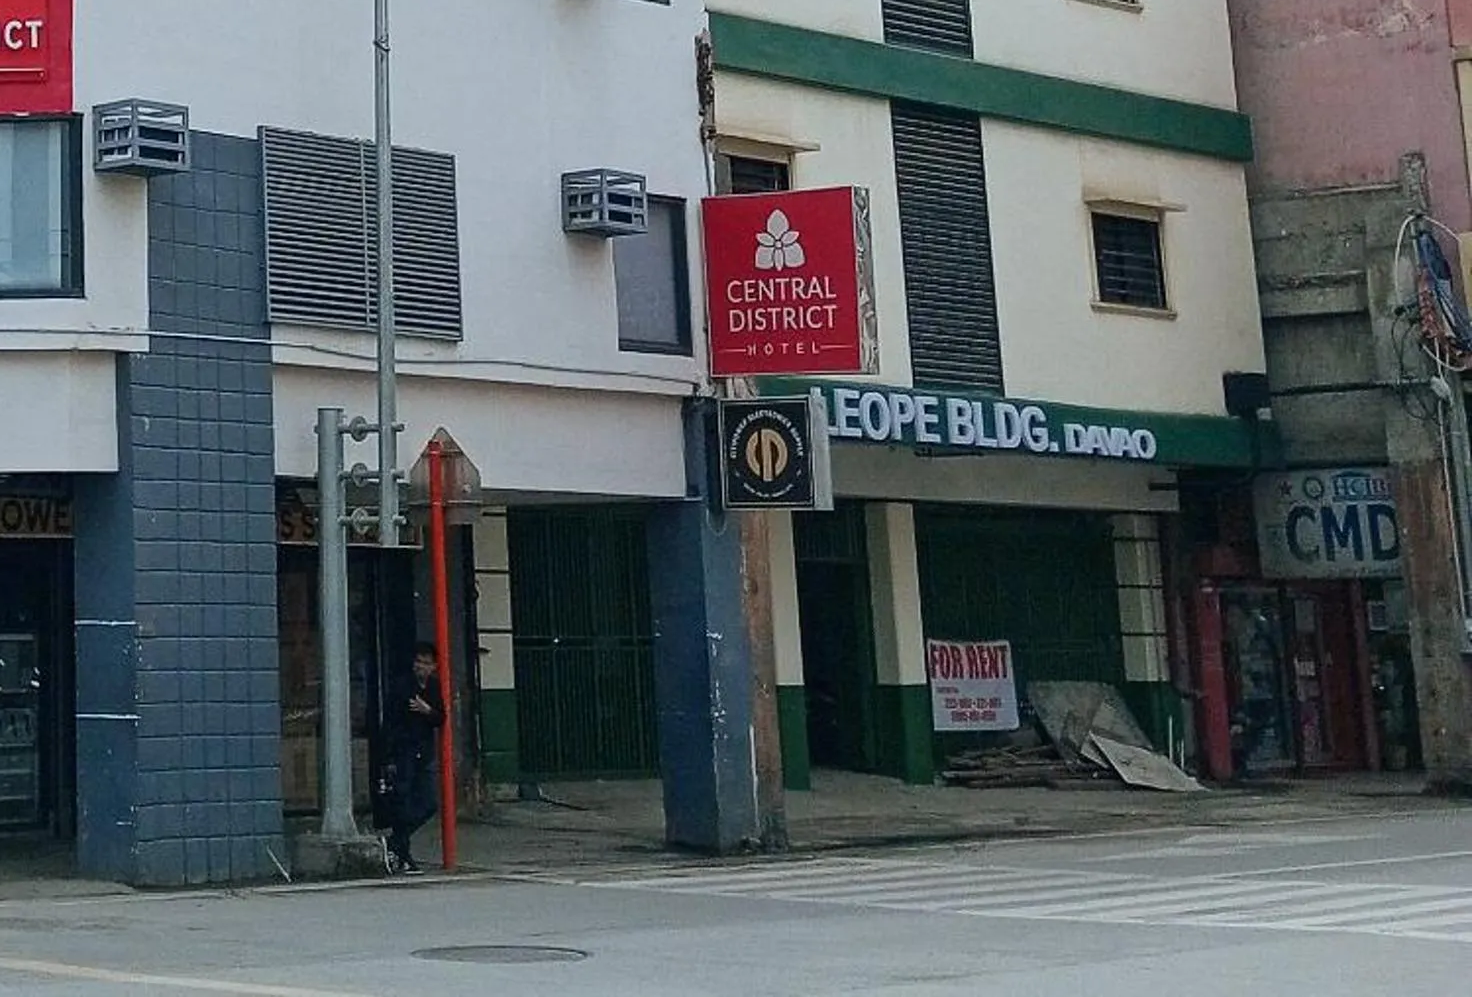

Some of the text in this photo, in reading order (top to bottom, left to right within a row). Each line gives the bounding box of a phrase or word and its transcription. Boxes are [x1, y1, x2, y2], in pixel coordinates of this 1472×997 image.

[727, 277, 837, 304] CENTRAL
[729, 305, 837, 333] DISTRICT
[747, 342, 820, 356] HOTEL
[947, 398, 1060, 452] BLDG.
[1064, 423, 1156, 459] DAVAO
[1285, 503, 1401, 563] CMD
[929, 643, 1009, 680] FOR RENT
